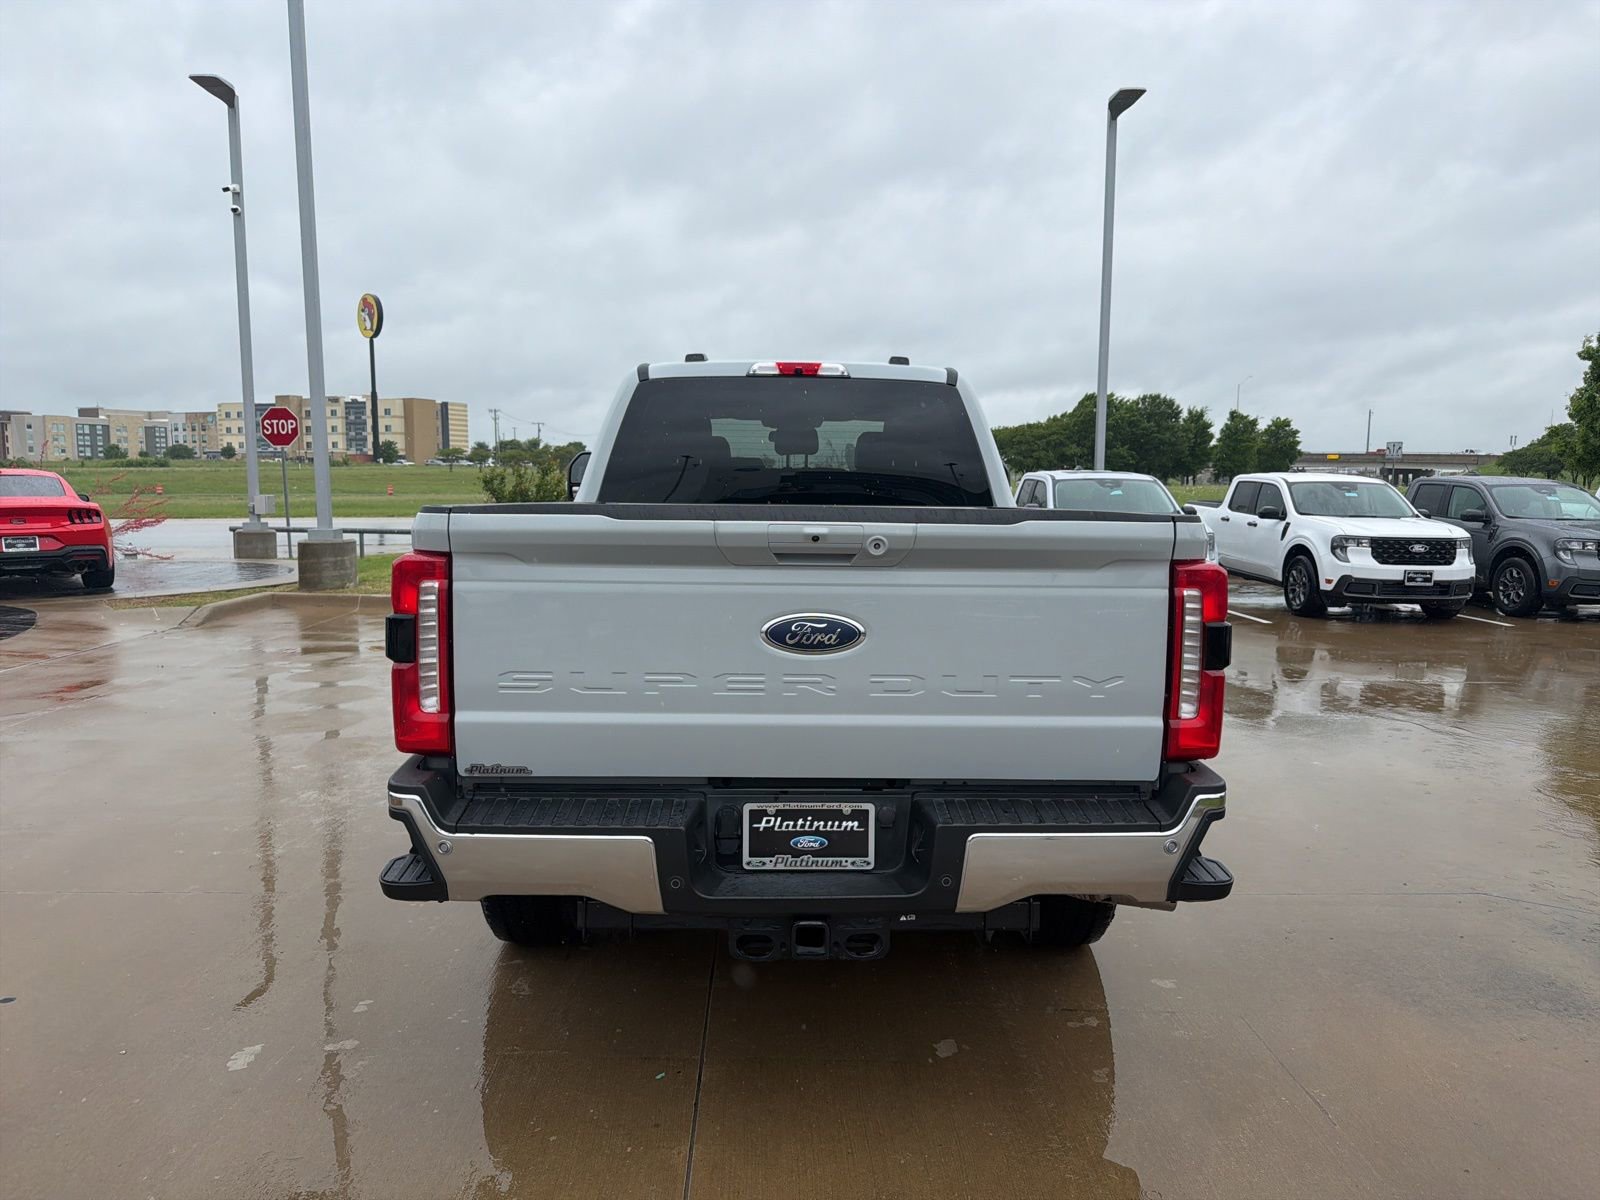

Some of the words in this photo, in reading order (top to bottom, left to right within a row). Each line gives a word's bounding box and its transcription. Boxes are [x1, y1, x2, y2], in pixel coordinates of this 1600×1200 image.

[263, 419, 296, 435] STOP
[785, 621, 842, 646] Ford
[497, 670, 837, 698] SUPER
[868, 673, 1125, 699] DUTY
[464, 763, 533, 776] Platinum
[752, 816, 864, 831] Platinum
[797, 837, 821, 849] Ford
[773, 855, 848, 868] Platinum
